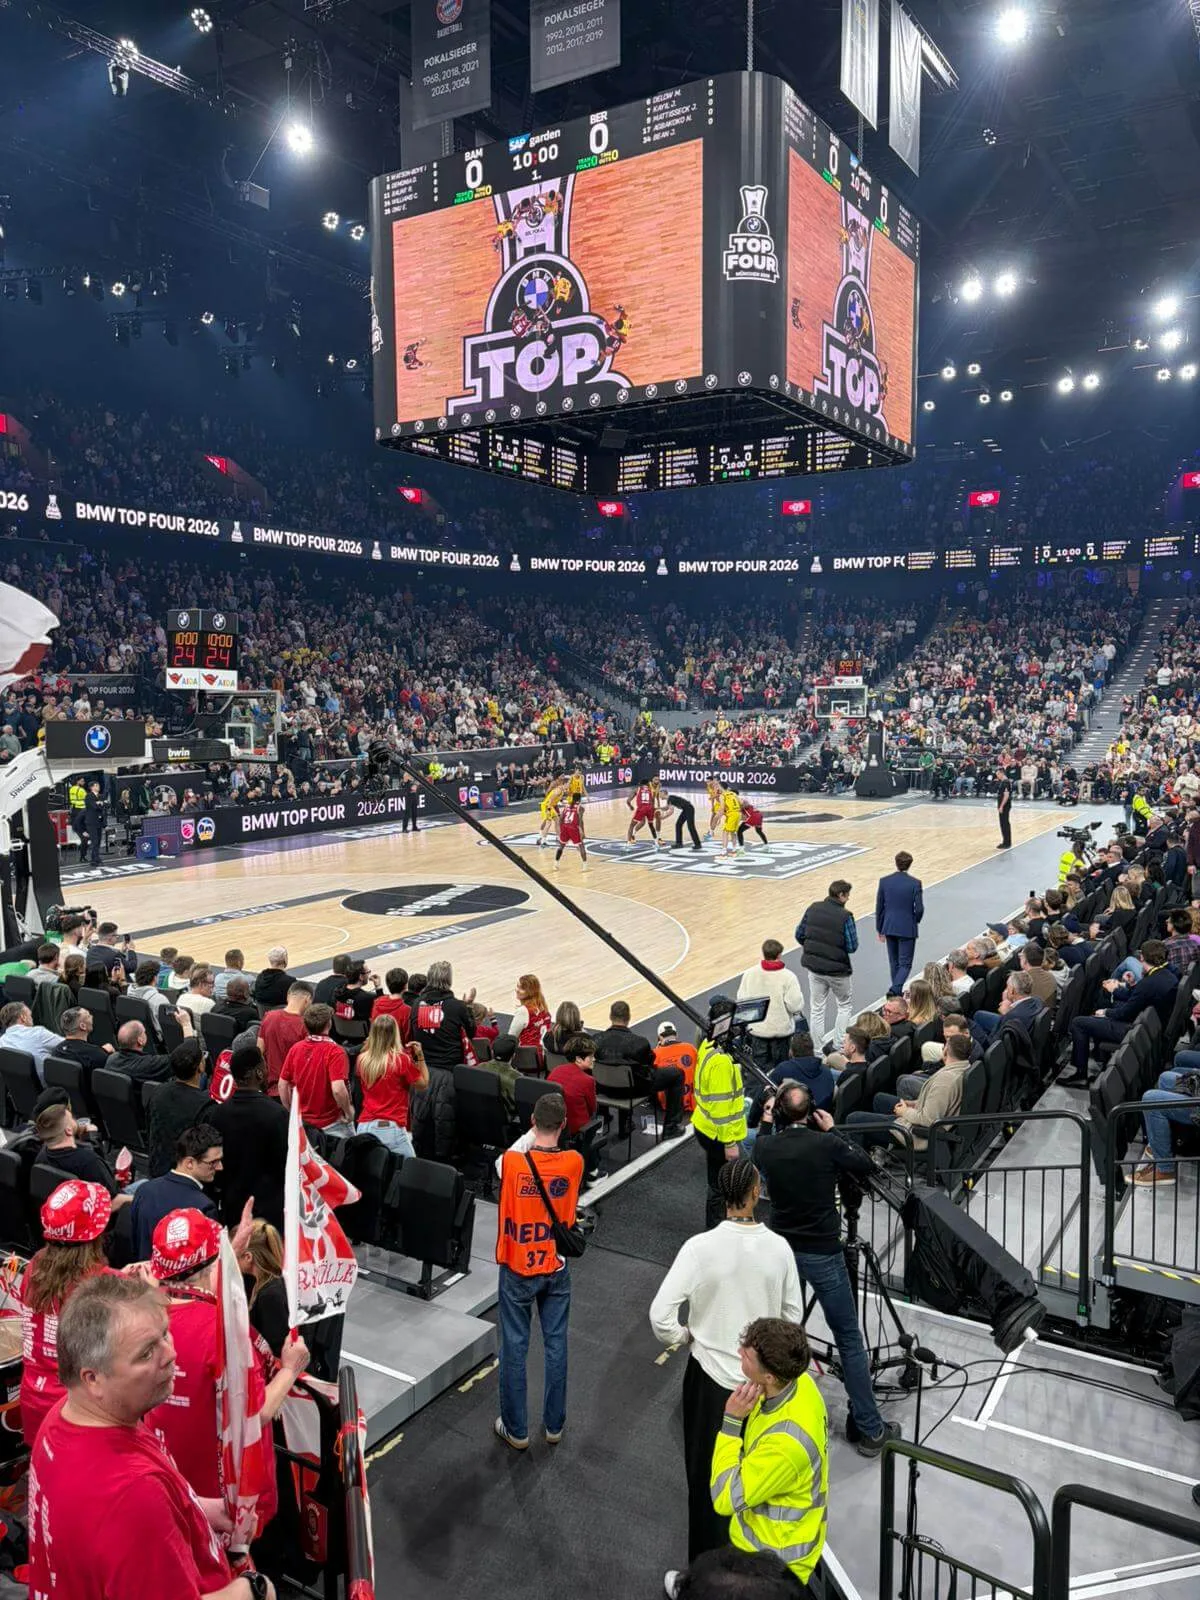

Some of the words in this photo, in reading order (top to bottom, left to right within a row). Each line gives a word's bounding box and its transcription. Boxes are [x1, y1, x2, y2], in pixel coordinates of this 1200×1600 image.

[544, 0, 605, 26] POKALSIEGER
[546, 29, 565, 42] 1992,
[586, 16, 603, 29] 2011
[585, 29, 604, 43] 2019
[424, 42, 477, 68] POKALSIEGER
[461, 59, 479, 73] 2021
[452, 76, 470, 91] 2024
[589, 110, 608, 125] BER
[509, 138, 526, 152] SAP
[529, 128, 561, 147] garden
[589, 122, 609, 154] 0
[464, 147, 484, 162] BAM
[512, 144, 559, 171] 10:00
[829, 145, 838, 176] 0
[465, 159, 483, 189] 0
[880, 196, 888, 223] 0
[733, 238, 772, 254] TOP
[727, 254, 776, 272] FOUR
[478, 332, 600, 400] TOP
[829, 344, 881, 417] TOP
[76, 502, 115, 523] BMW
[117, 508, 147, 526] TOP
[149, 513, 185, 532] FOUR
[188, 518, 220, 536] 2026
[253, 527, 284, 545] BMW
[285, 532, 307, 547] TOP
[308, 535, 336, 552] FOUR
[337, 539, 363, 555] 2026
[390, 546, 419, 561] BMW
[419, 550, 441, 563] TOP
[442, 551, 470, 566] FOUR
[472, 553, 500, 568] 2026
[1056, 548, 1081, 557] 10:00
[530, 557, 561, 570] BMW
[561, 558, 584, 571] TOP
[585, 558, 616, 572] FOUR
[617, 560, 646, 573] 2026
[678, 560, 709, 573] BMW
[710, 560, 734, 573] TOP
[735, 560, 767, 572] FOUR
[768, 559, 799, 571] 2026
[833, 557, 865, 570] BMW
[867, 556, 891, 568] TOP
[176, 632, 198, 645] 10:00
[207, 633, 233, 648] 10:00
[174, 646, 195, 666] 24
[206, 648, 230, 669] 24
[88, 686, 98, 695] OP
[167, 747, 190, 758] bwin
[585, 770, 613, 787] FINALE
[659, 769, 690, 783] BMW
[690, 770, 711, 783] TOP
[713, 771, 745, 784] OUR
[747, 772, 777, 785] 2026
[357, 801, 386, 817] 2026
[387, 794, 426, 812] FINE
[242, 812, 279, 832] BMW
[280, 807, 309, 827] TOP
[311, 804, 346, 822] FOUR
[219, 1074, 234, 1100] 0
[526, 1250, 548, 1268] 37
